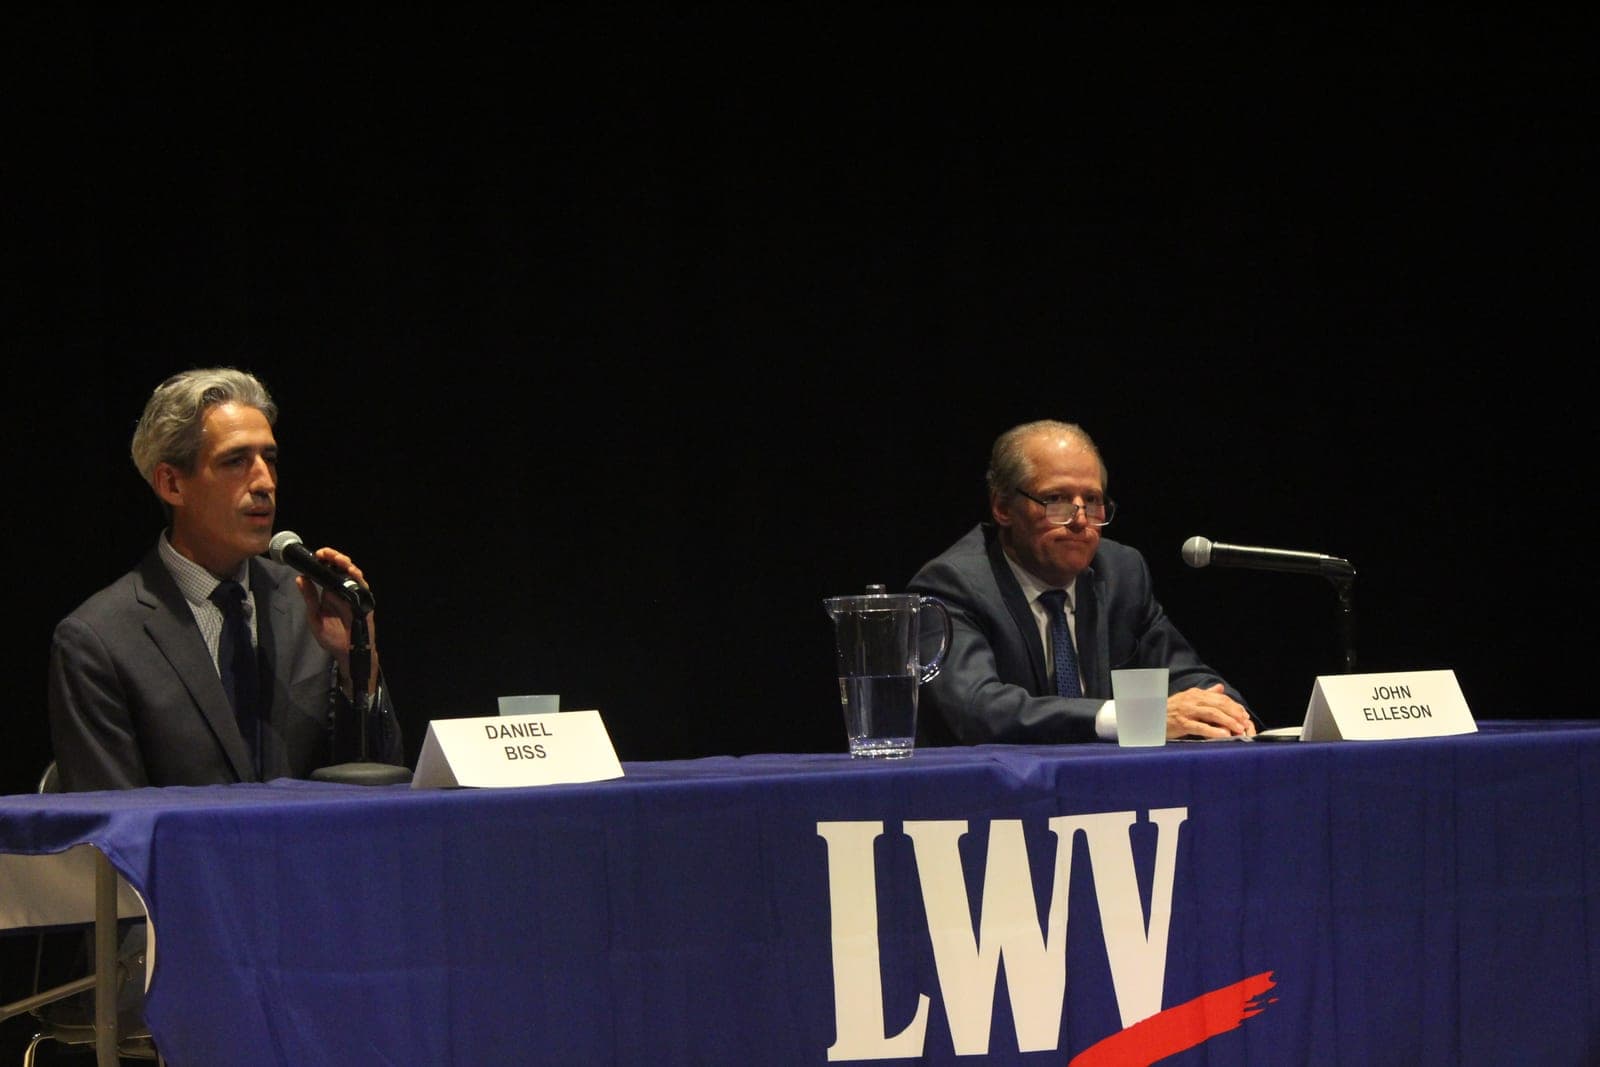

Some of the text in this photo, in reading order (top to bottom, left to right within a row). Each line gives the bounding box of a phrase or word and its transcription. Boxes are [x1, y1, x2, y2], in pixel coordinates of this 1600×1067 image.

[1371, 685, 1412, 701] JOHN
[1363, 704, 1433, 721] ELLESON
[485, 722, 553, 740] DANIEL
[504, 744, 547, 761] BISS
[816, 806, 1188, 1062] LWV
